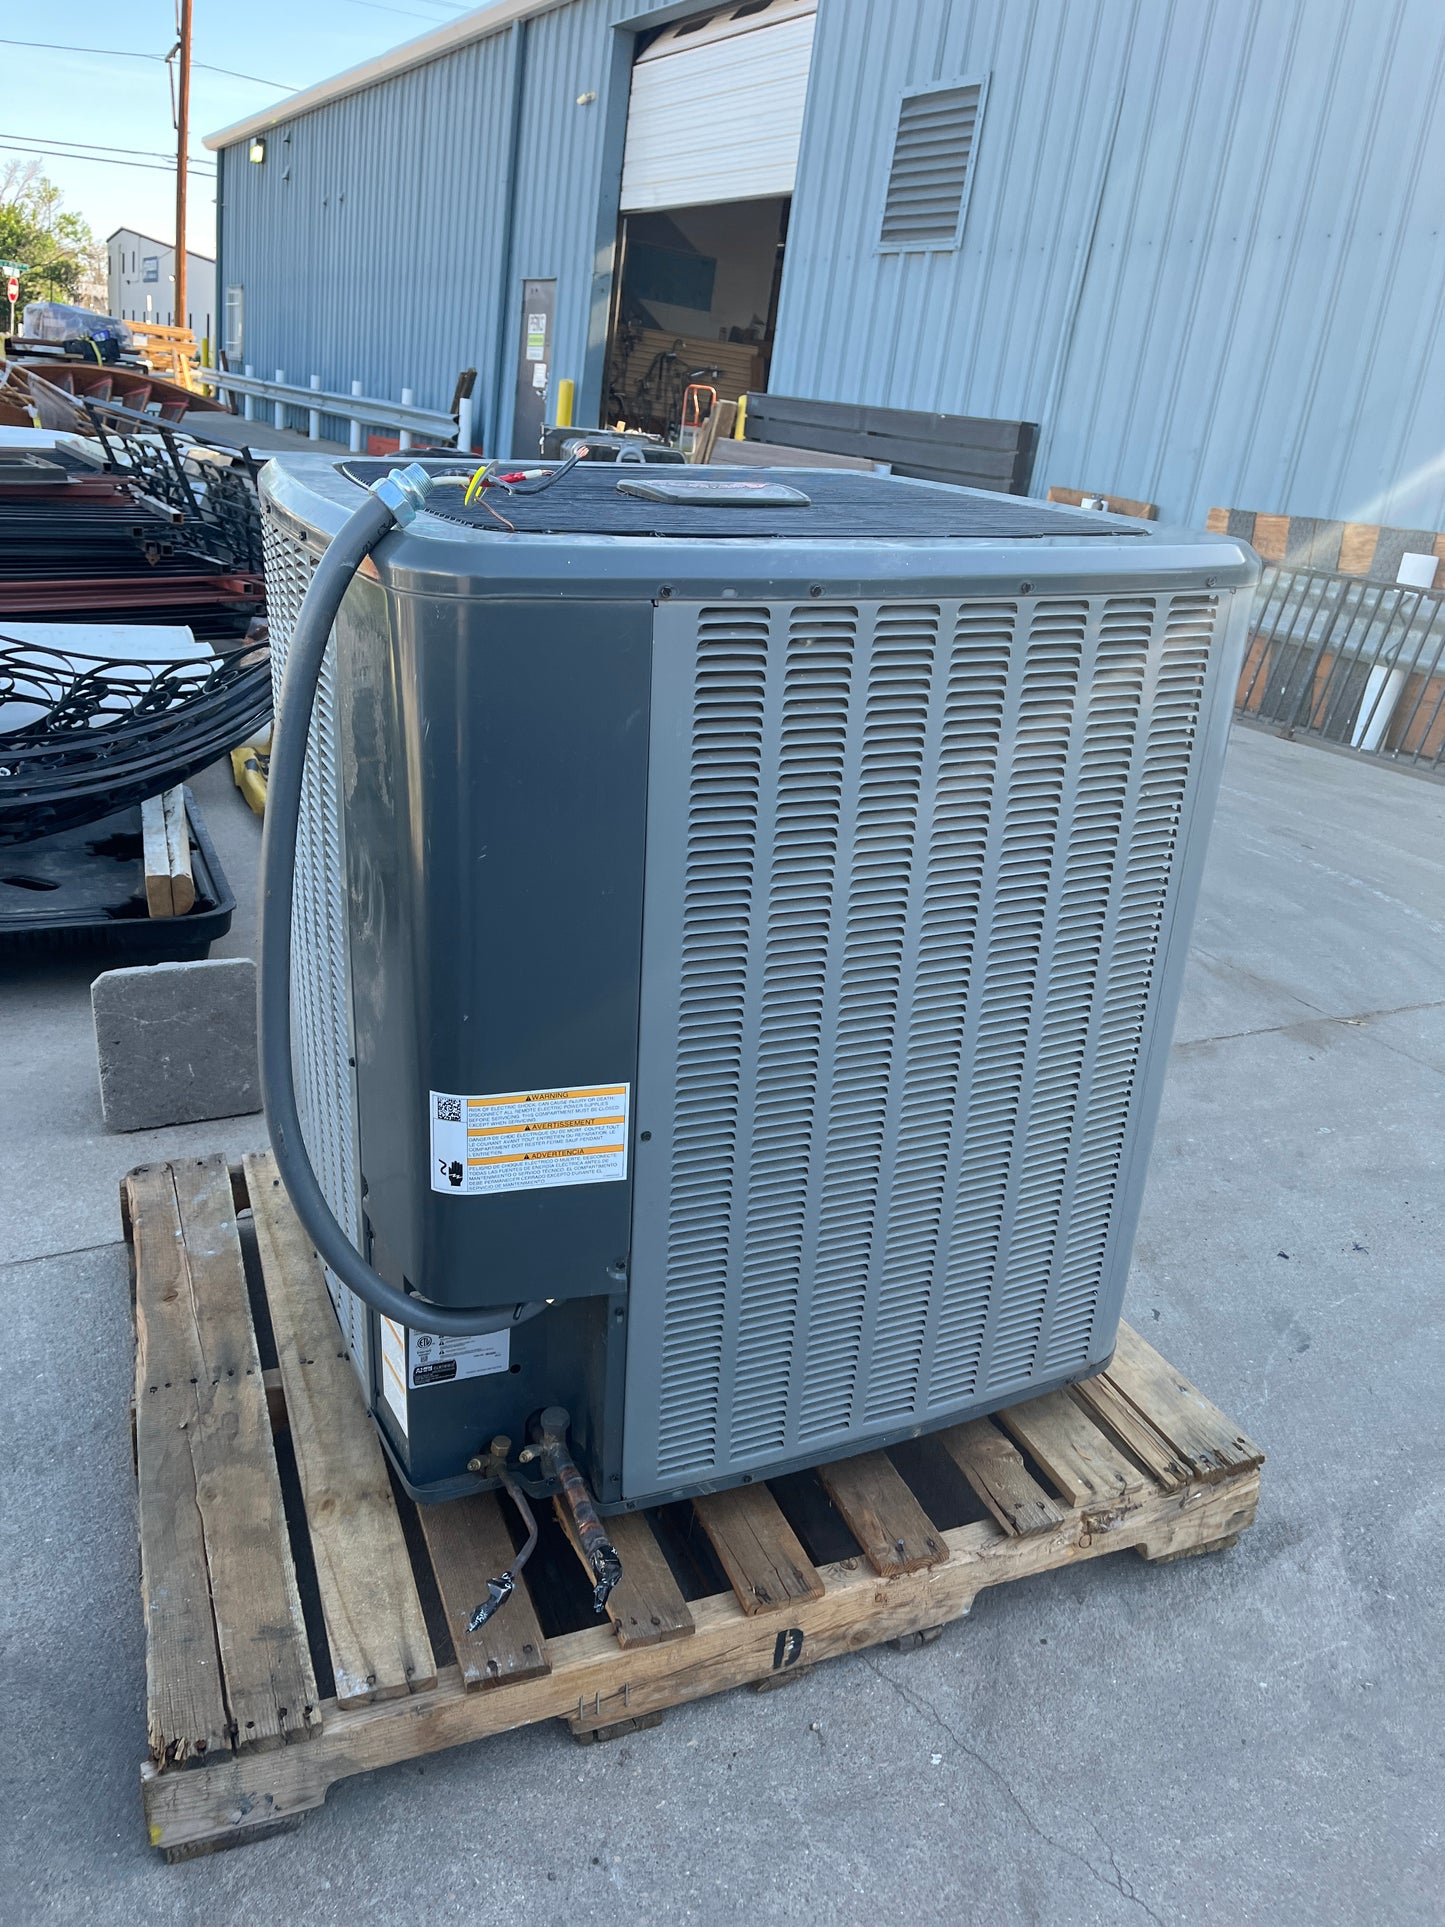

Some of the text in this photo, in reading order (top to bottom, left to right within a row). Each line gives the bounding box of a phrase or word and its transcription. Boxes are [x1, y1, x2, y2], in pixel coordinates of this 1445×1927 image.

[532, 1092, 568, 1100] WARNING
[532, 1118, 595, 1130] AVERTISSEMENT
[532, 1148, 584, 1159] ADVERTENCIA
